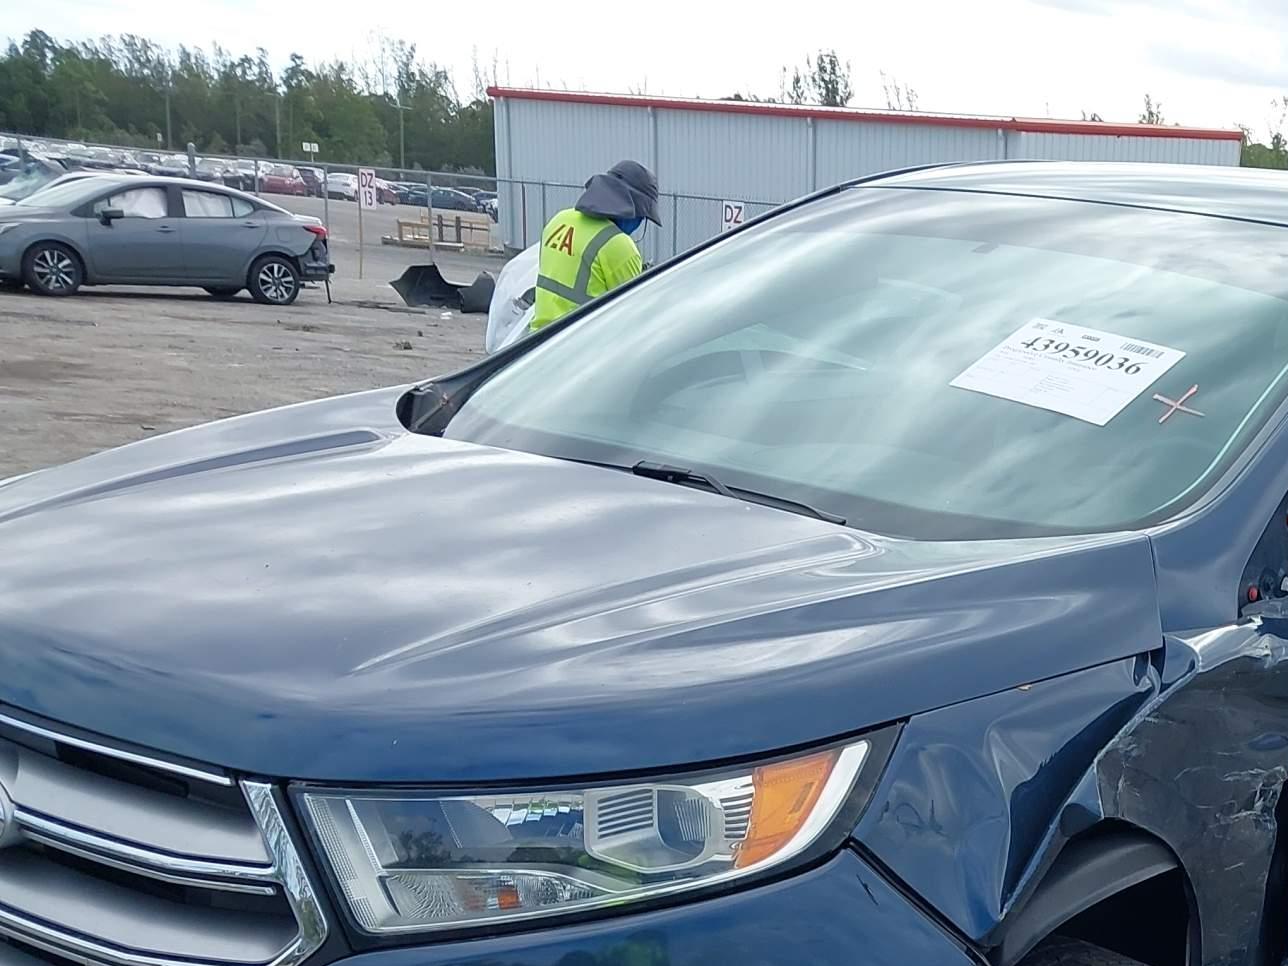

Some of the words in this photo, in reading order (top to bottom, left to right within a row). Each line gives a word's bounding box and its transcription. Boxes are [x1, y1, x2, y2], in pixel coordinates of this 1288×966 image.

[361, 172, 374, 188] DZ
[364, 190, 373, 206] 13
[724, 205, 742, 224] DZ
[1021, 336, 1149, 375] 43959036
